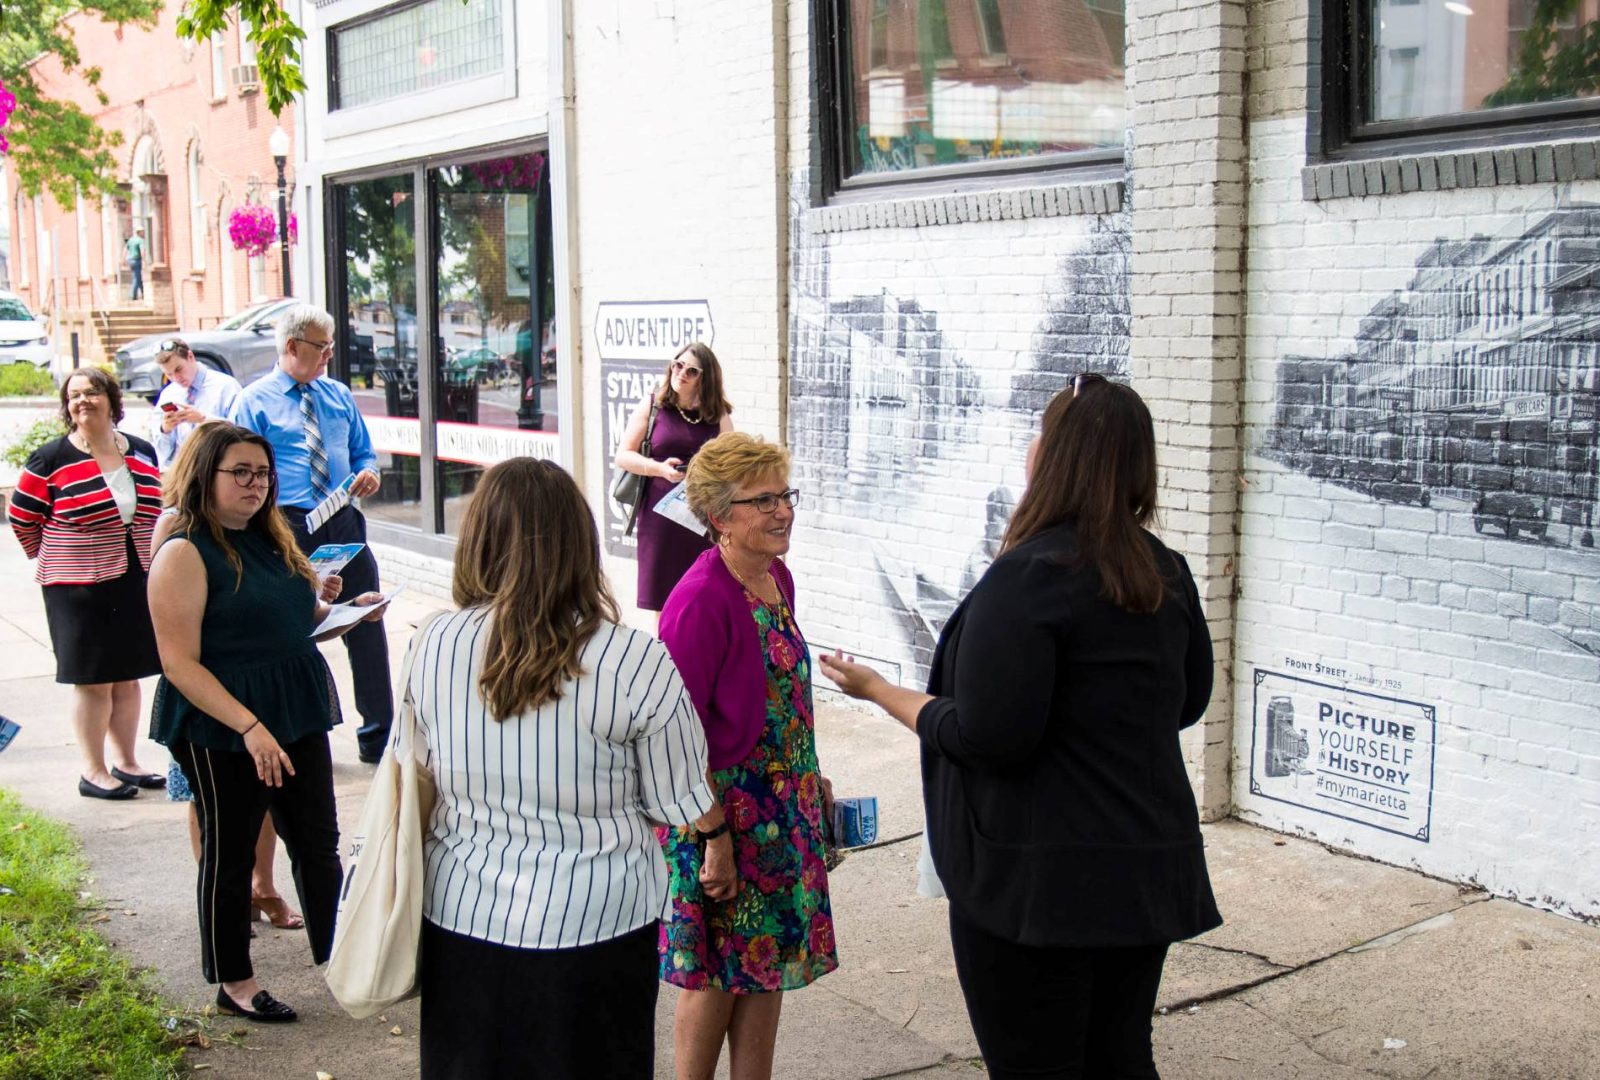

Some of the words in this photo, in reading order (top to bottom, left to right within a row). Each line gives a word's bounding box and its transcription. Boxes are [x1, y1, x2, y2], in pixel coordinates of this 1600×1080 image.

[604, 317, 704, 348] ADVENTURE
[1528, 398, 1545, 413] CARS
[477, 434, 499, 457] SODA
[505, 438, 518, 459] ICE
[523, 440, 554, 461] CREAM
[1285, 657, 1313, 671] FRONT
[1314, 662, 1347, 678] STREET
[1355, 673, 1382, 687] January
[1385, 679, 1402, 690] 1925
[1318, 702, 1416, 742] PICTURE
[1318, 728, 1413, 766] YOURSELF
[1329, 750, 1411, 786] HISTORY
[1316, 775, 1407, 811] #mymarietta
